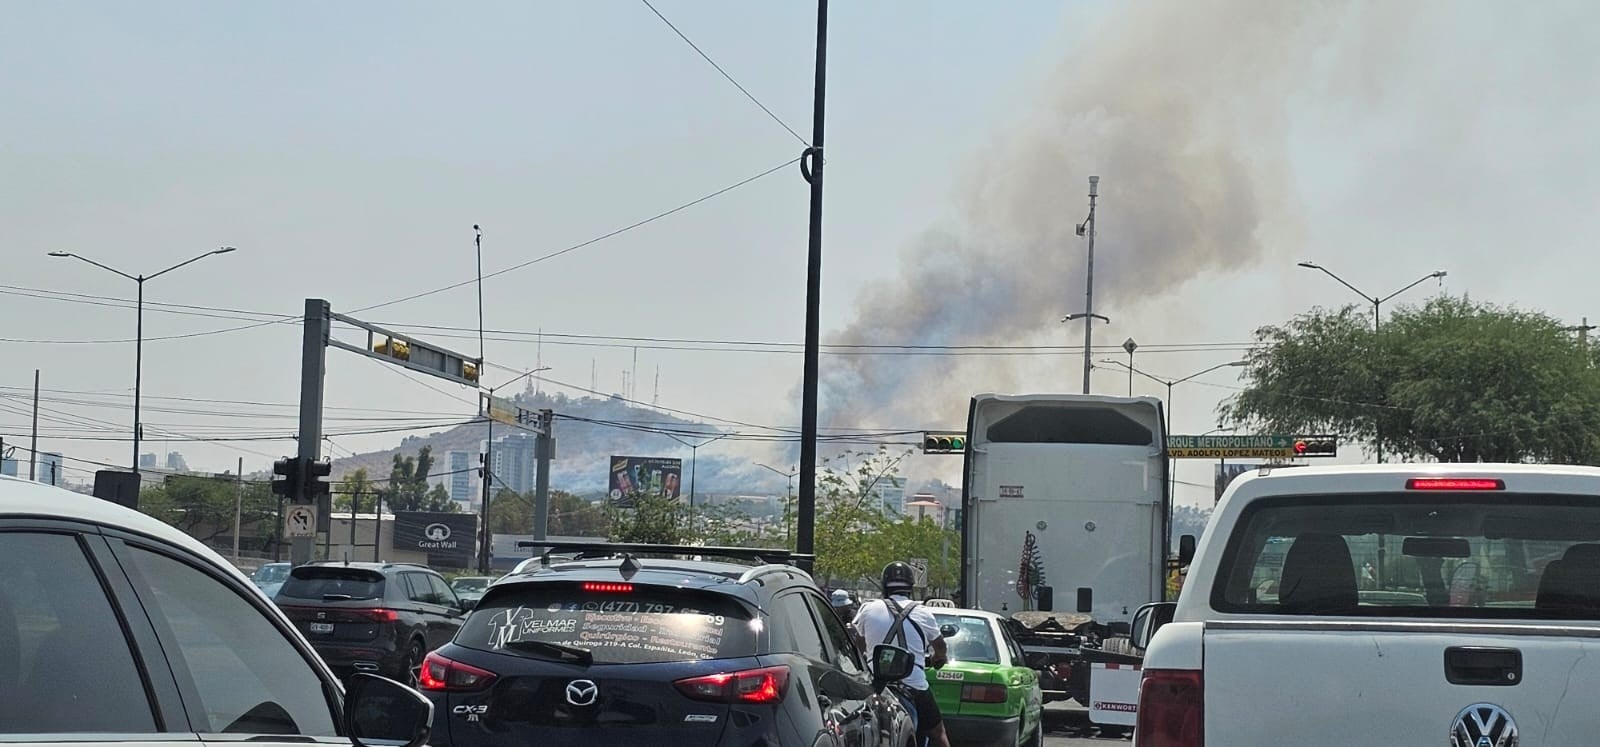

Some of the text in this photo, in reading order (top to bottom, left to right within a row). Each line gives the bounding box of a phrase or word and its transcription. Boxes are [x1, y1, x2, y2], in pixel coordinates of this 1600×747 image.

[1167, 436, 1273, 448] RQUE METROPOLITANO
[1168, 449, 1286, 457] LVD. ADOLFO LOPEZ MATEOS
[418, 540, 439, 548] Great
[600, 600, 640, 615] (477)
[524, 619, 577, 628] VELMAR
[582, 622, 648, 633] Seguridad
[573, 639, 602, 647] Quiroga
[628, 641, 643, 649] Col.
[453, 704, 488, 714] CX-3
[1102, 703, 1138, 711] KENWORT
